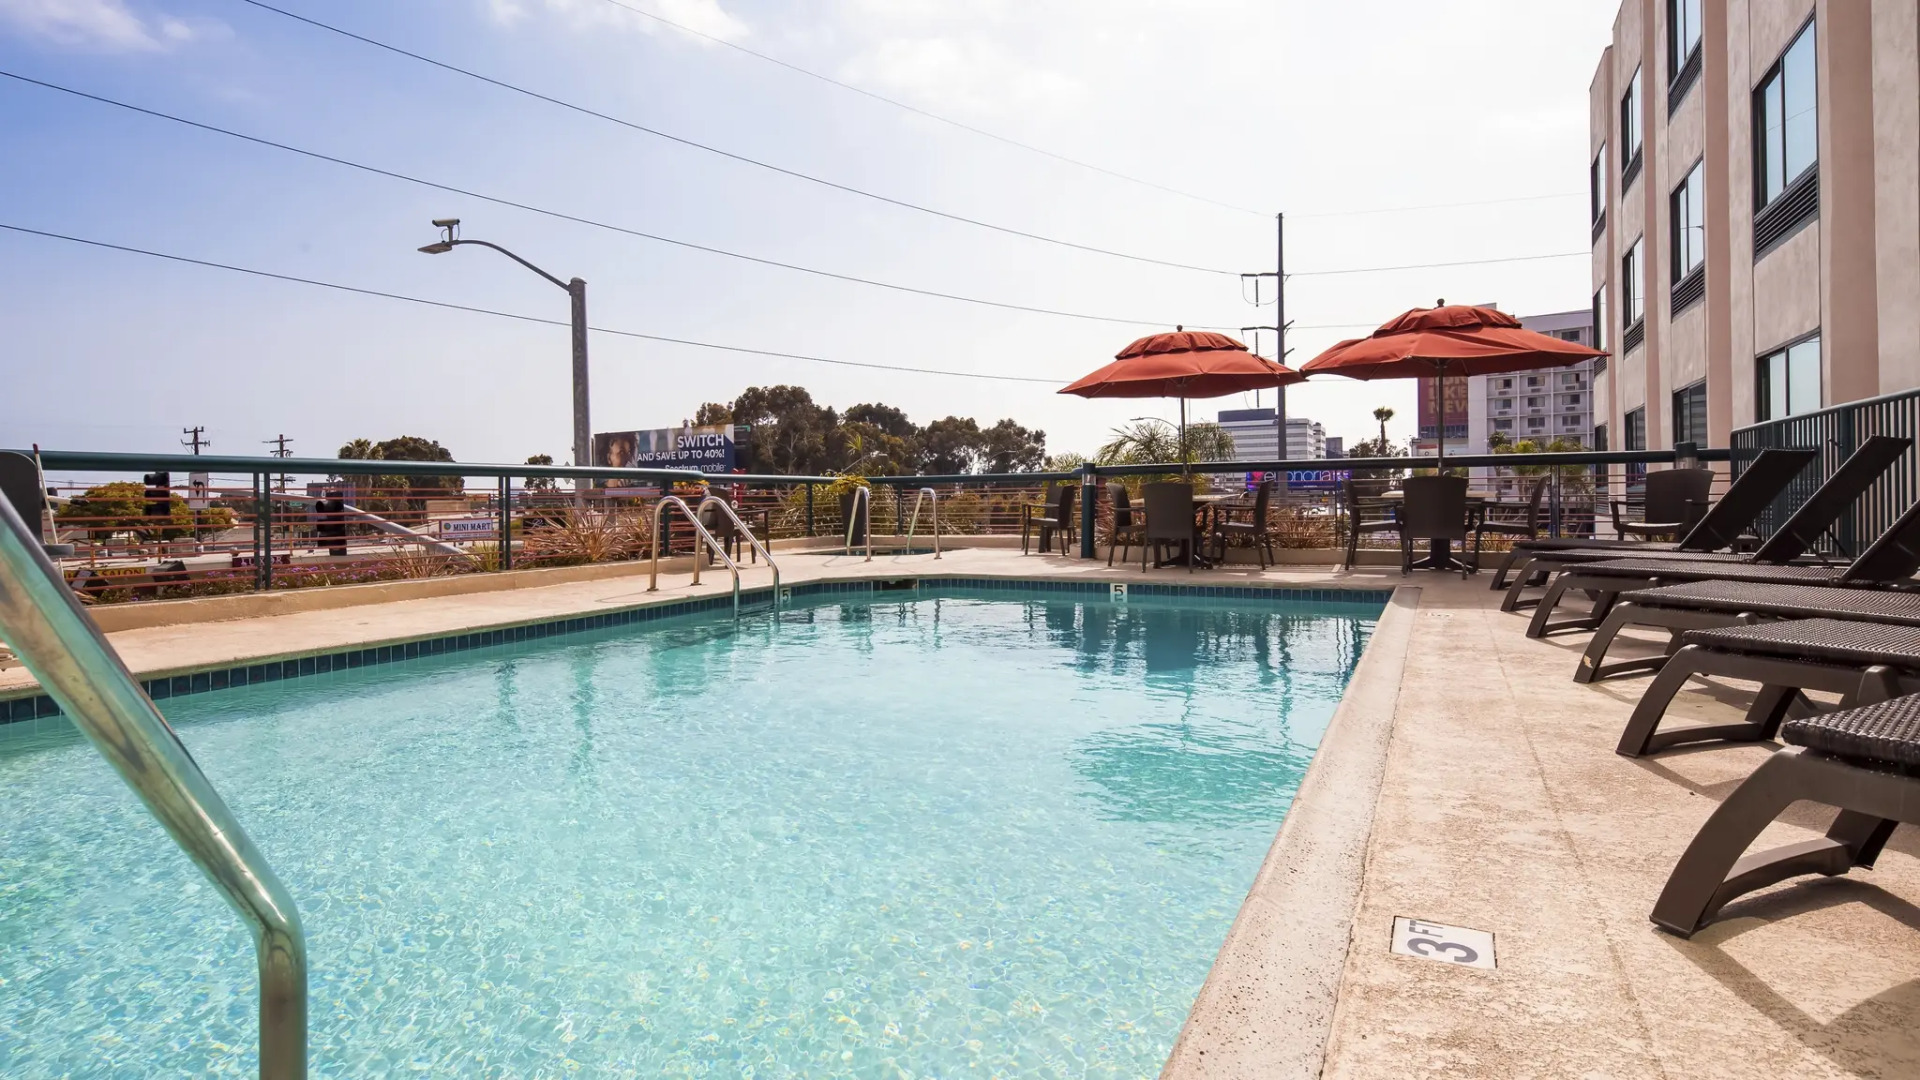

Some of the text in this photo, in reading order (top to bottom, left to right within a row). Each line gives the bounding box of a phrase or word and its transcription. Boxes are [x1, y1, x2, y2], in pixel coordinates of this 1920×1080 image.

[677, 434, 724, 448] SWITCH
[637, 448, 725, 461] AND SAVE UP TO 40%!
[453, 522, 491, 531] MINI MART
[101, 567, 142, 577] SALON
[782, 589, 789, 604] 5
[1114, 585, 1124, 596] 5
[1407, 920, 1478, 963] 3 FT
